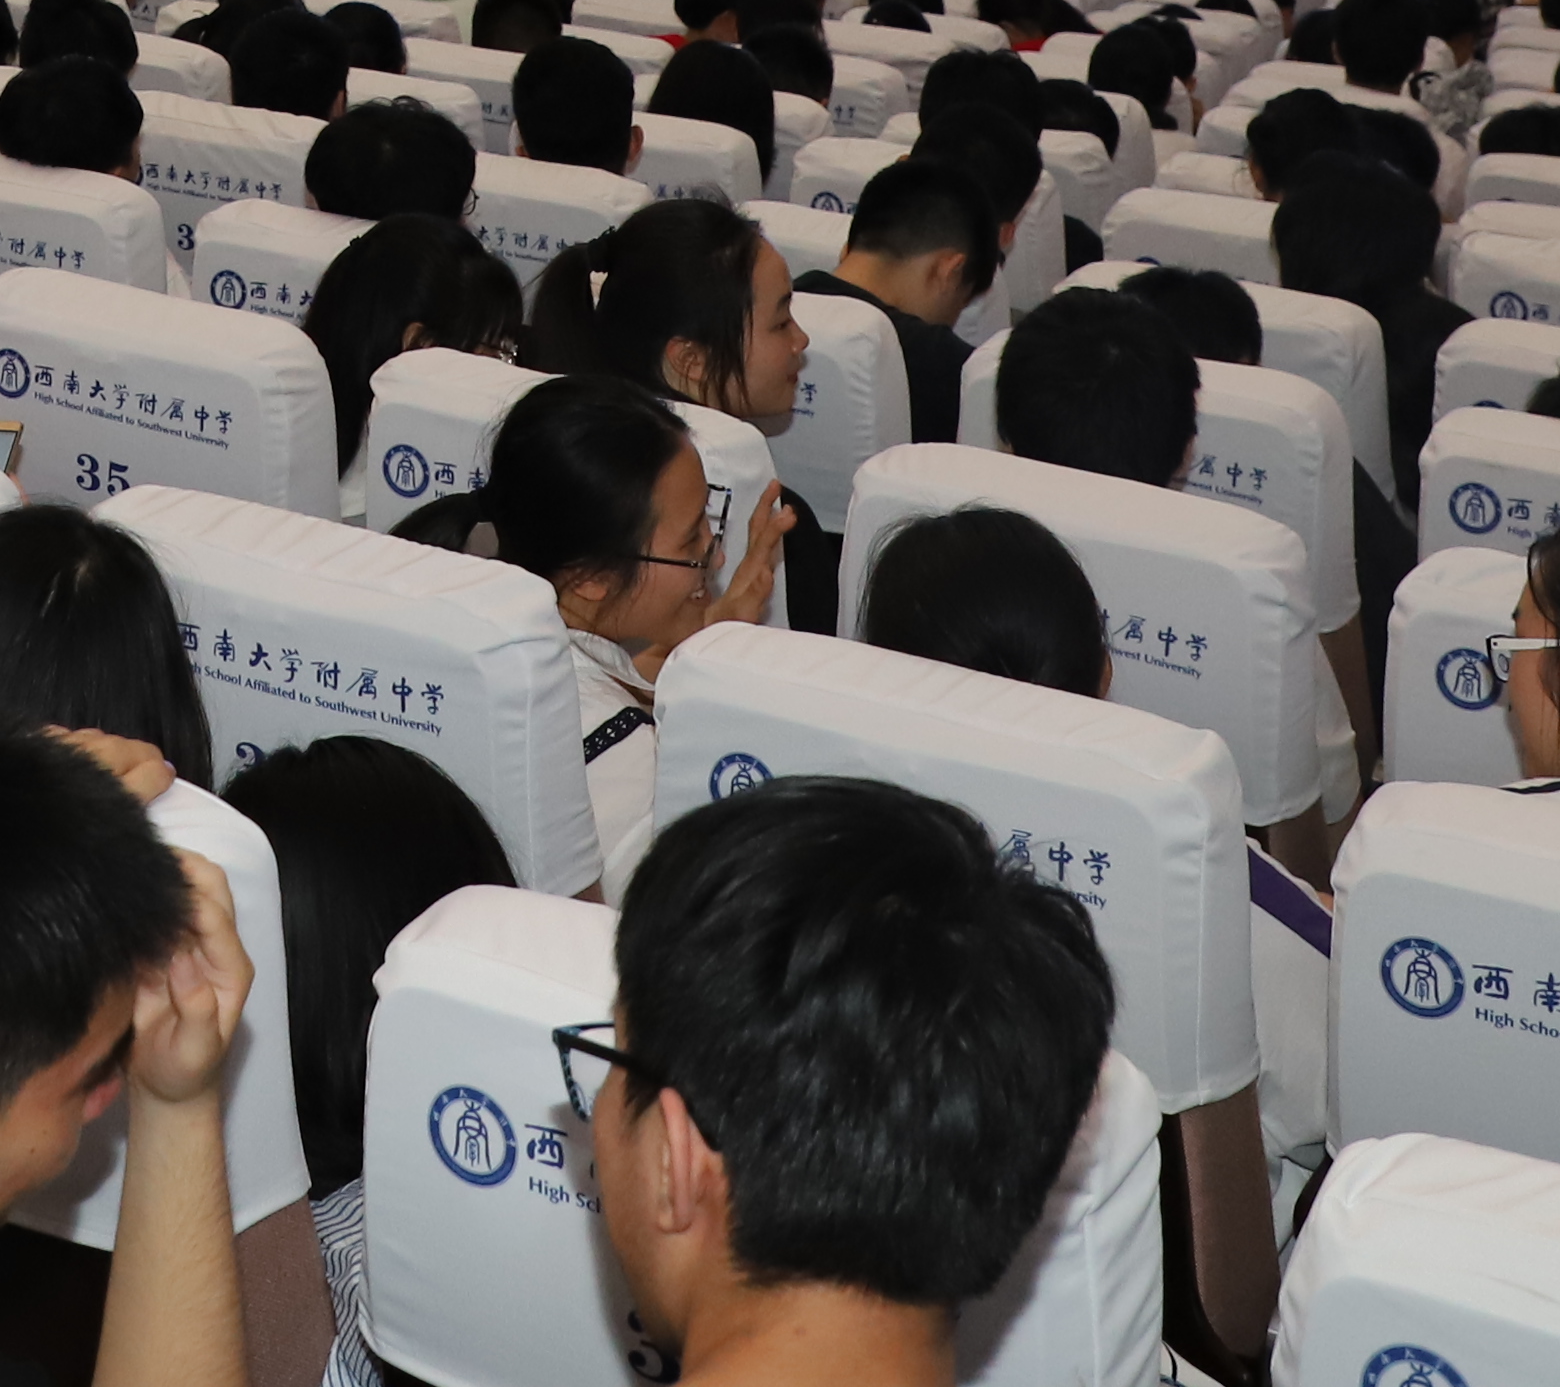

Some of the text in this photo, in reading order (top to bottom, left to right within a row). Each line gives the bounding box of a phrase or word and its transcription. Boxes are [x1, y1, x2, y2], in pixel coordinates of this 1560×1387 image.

[35, 365, 234, 435] 西南大学附属中学
[76, 453, 130, 498] 35
[1474, 1005, 1516, 1033] High
